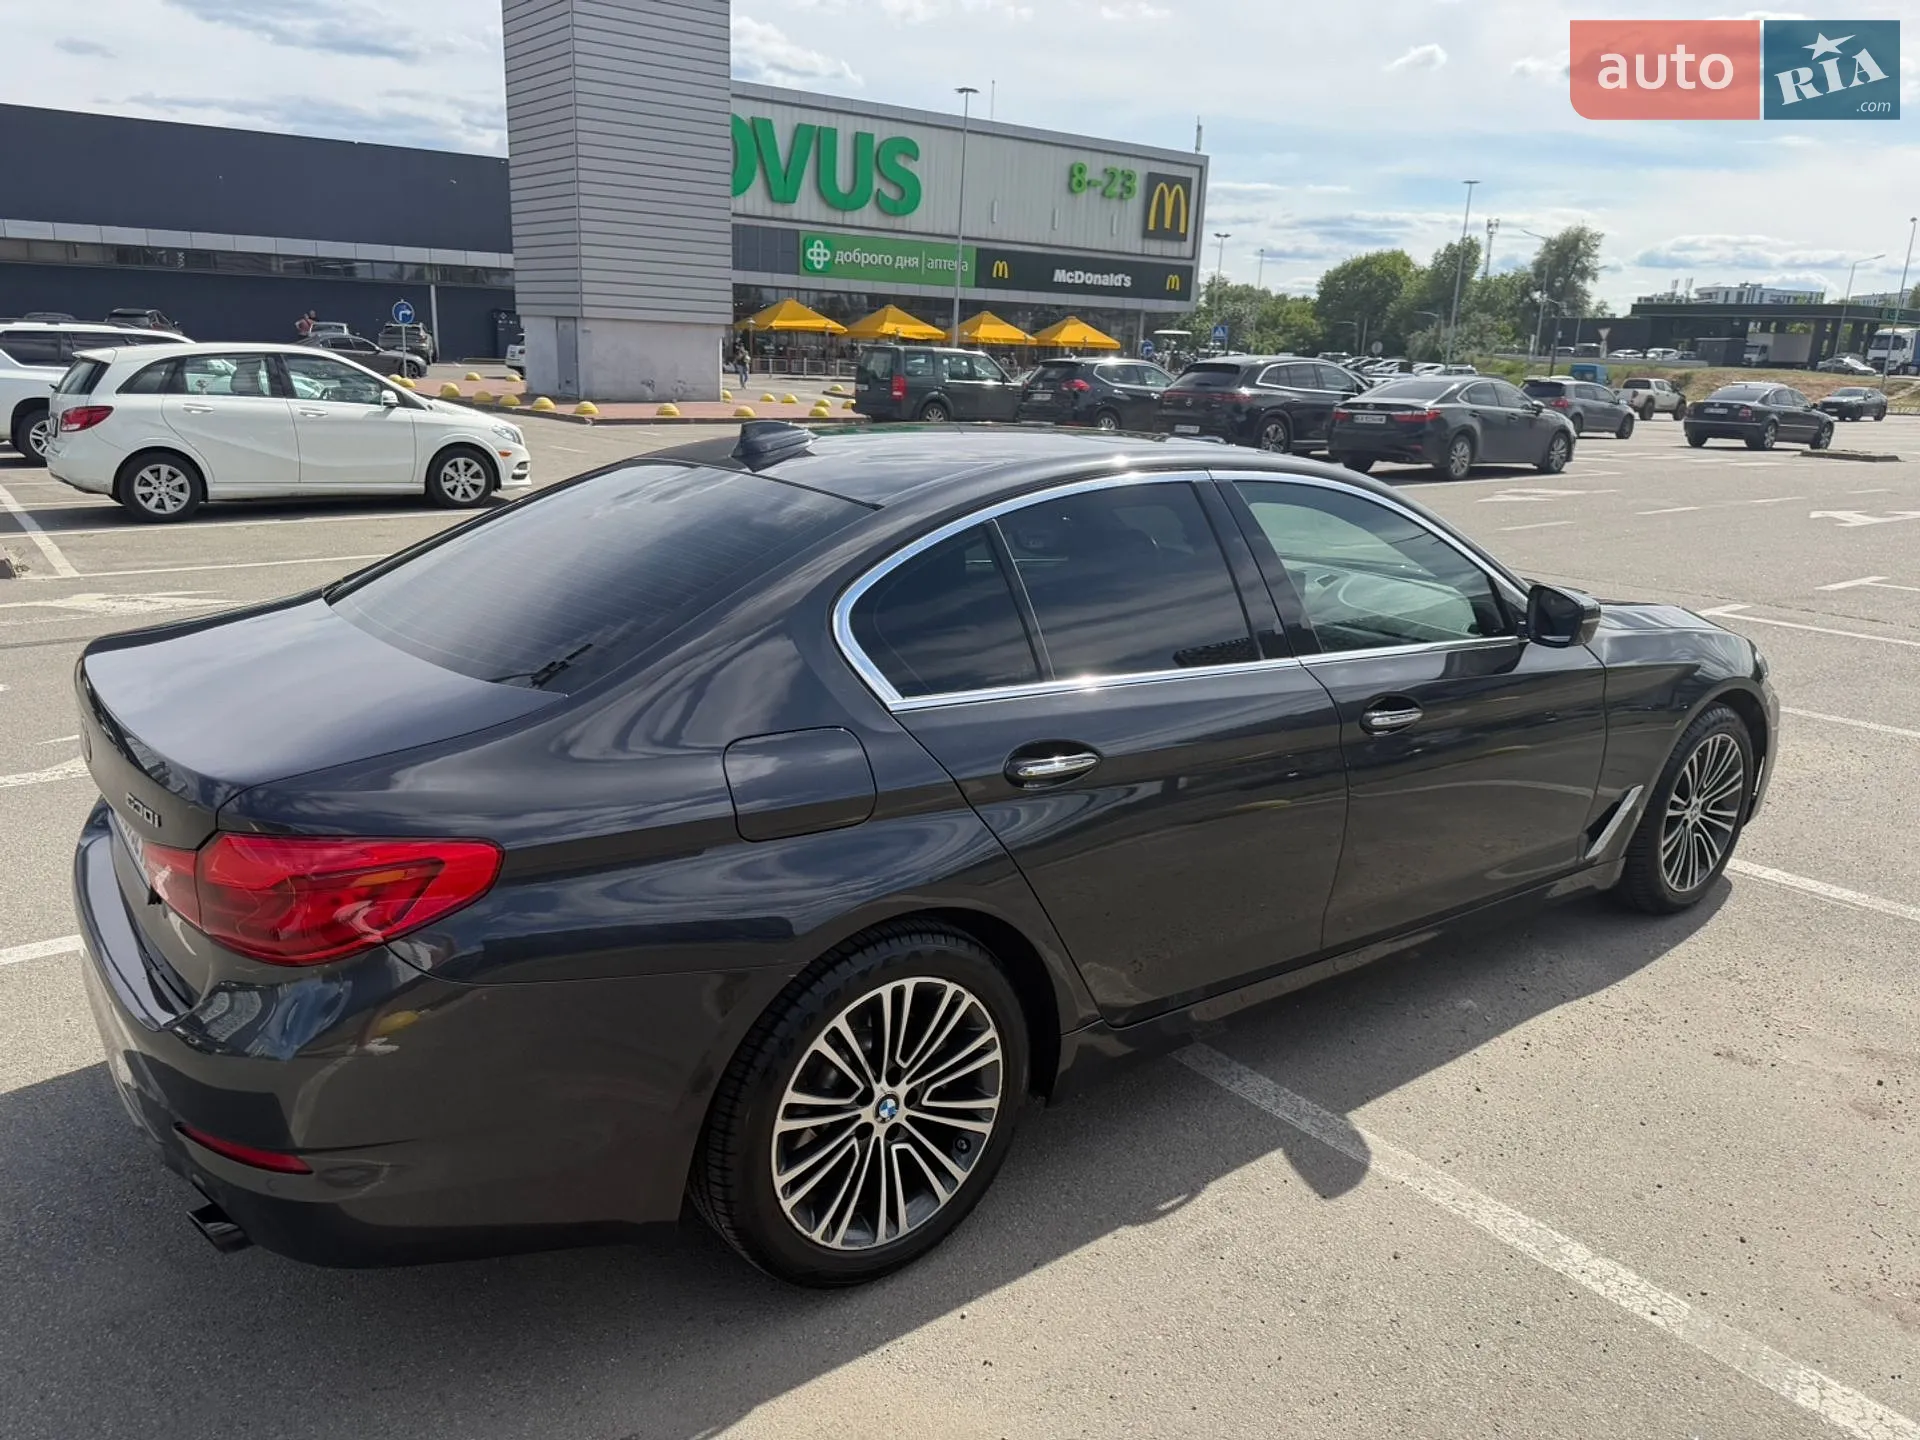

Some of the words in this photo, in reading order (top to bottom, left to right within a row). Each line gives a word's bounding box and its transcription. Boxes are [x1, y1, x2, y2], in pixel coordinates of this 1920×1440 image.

[834, 248, 892, 268] доброго
[895, 256, 919, 269] дня
[1053, 269, 1132, 288] McDonald's
